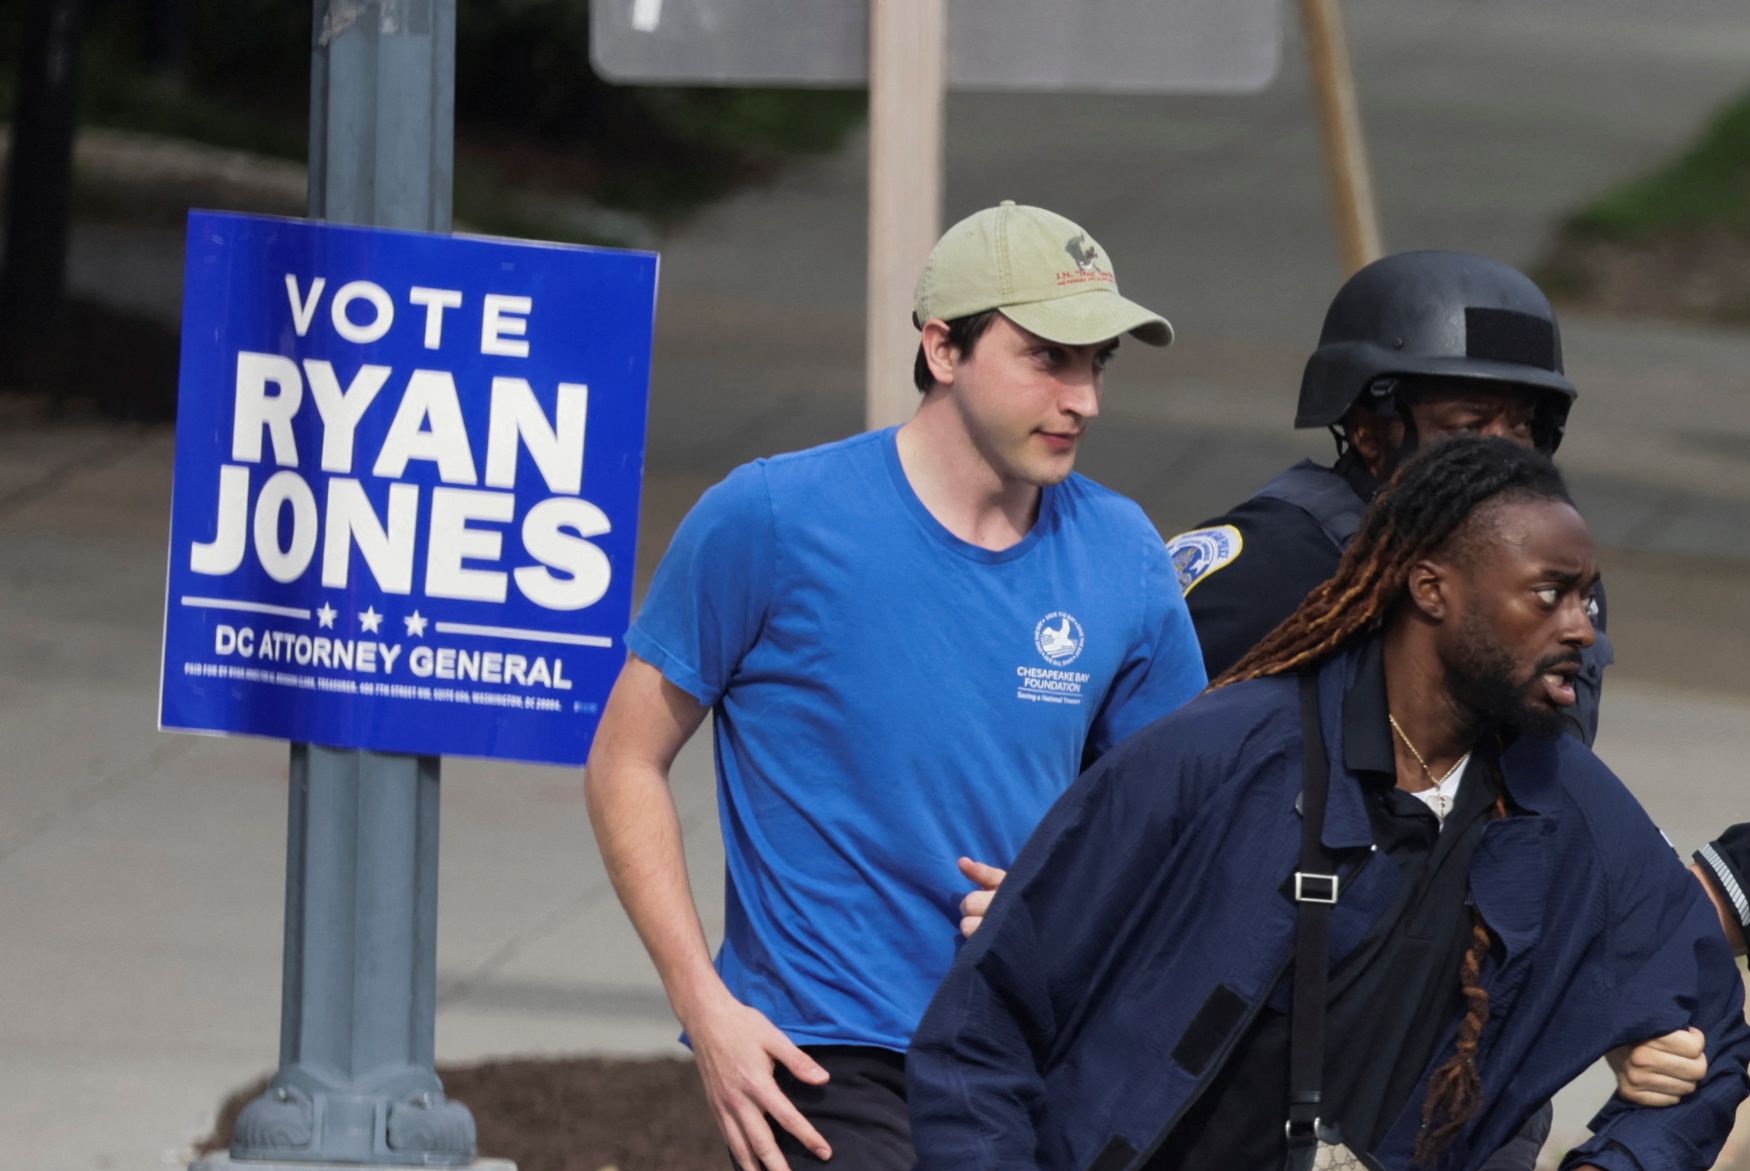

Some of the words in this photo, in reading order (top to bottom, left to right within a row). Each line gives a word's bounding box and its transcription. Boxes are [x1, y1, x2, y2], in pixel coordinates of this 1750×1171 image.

[285, 273, 533, 358] VOTE
[231, 350, 589, 496] RYAN
[189, 464, 613, 611] JONES
[214, 624, 255, 658] DC
[258, 629, 401, 675] ATTORNEY
[408, 646, 573, 691] GENERAL
[1017, 666, 1074, 681] CHESAPEAKE
[1074, 672, 1090, 683] BAY
[1024, 677, 1081, 692] FOUNDATION
